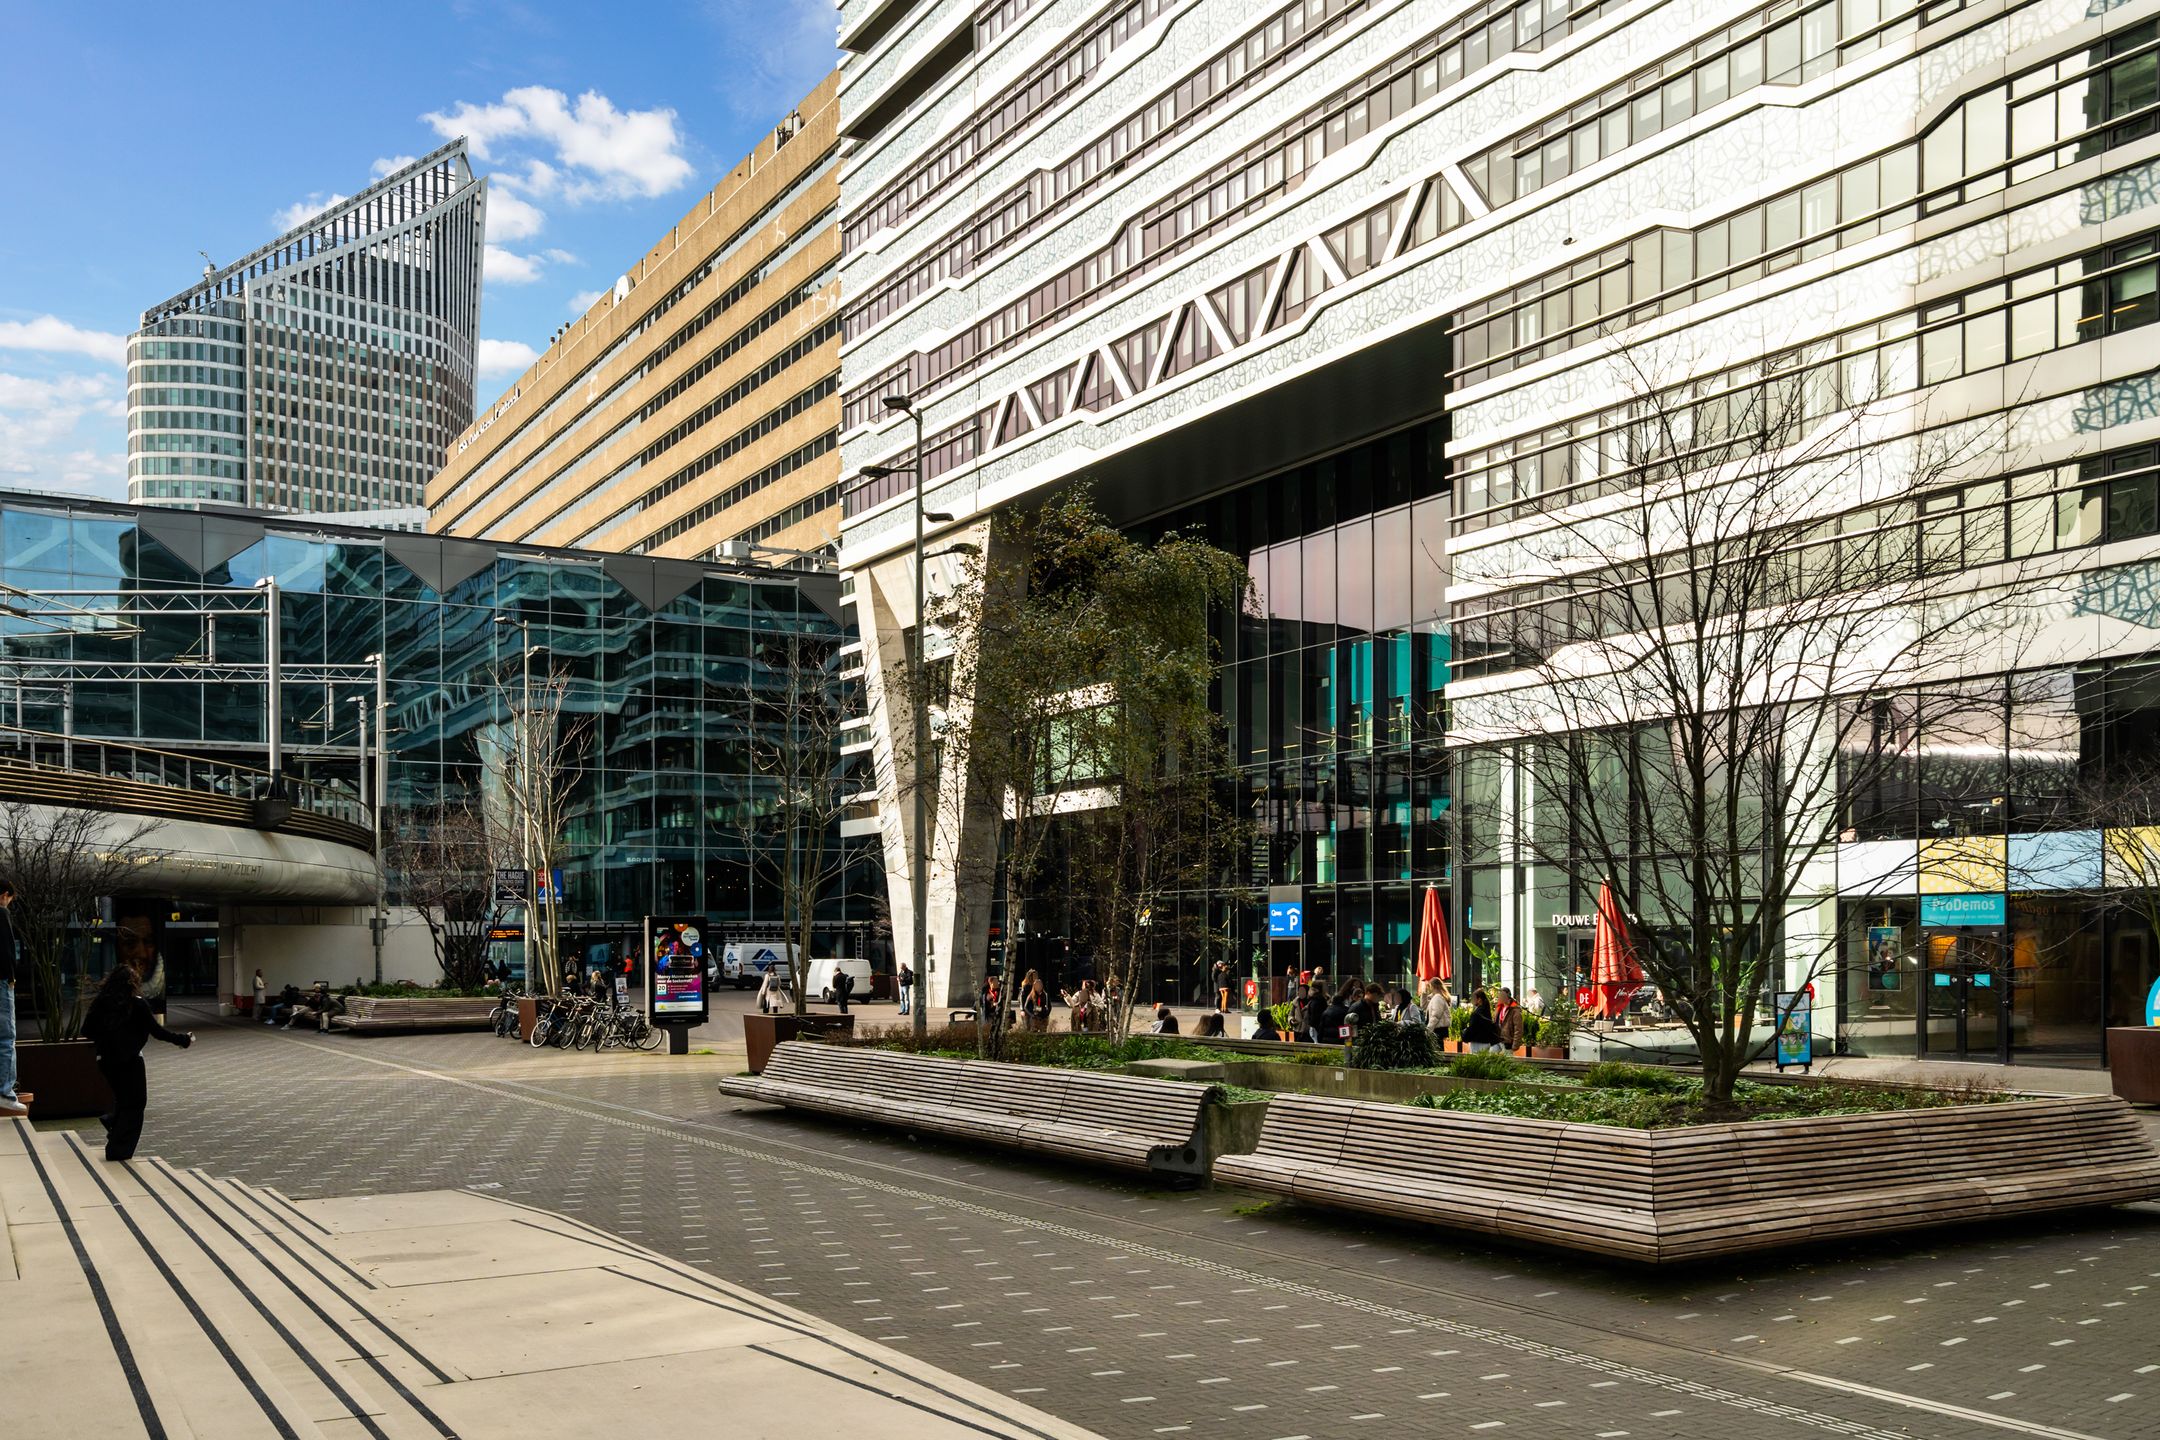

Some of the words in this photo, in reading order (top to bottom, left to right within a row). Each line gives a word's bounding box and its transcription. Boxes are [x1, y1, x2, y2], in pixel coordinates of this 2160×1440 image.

[496, 871, 507, 880] THE
[507, 871, 525, 880] HAGUE
[1932, 898, 1996, 912] ProDemos
[1289, 914, 1299, 931] P
[1552, 914, 1590, 926] DOUWE
